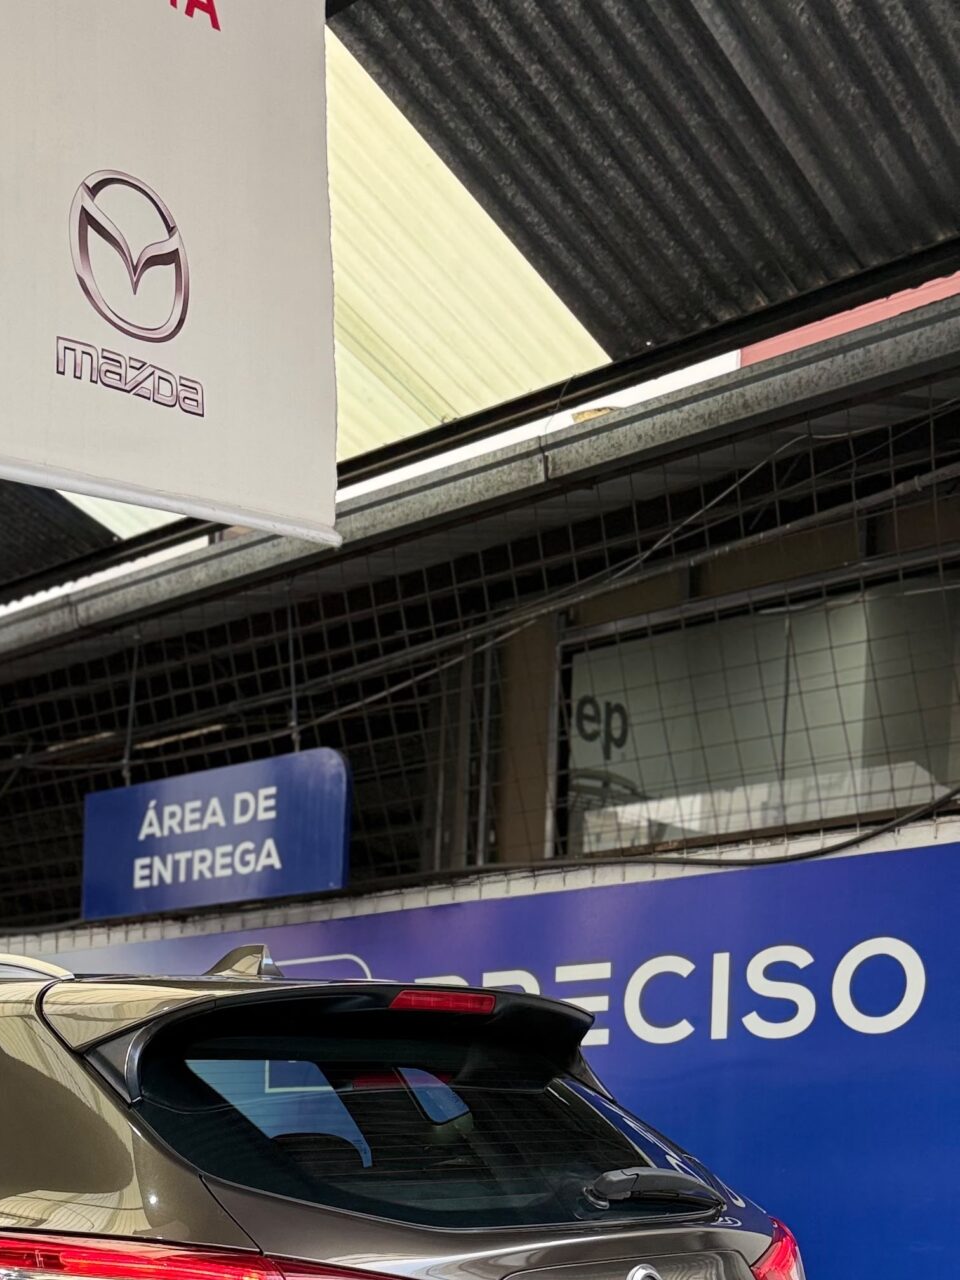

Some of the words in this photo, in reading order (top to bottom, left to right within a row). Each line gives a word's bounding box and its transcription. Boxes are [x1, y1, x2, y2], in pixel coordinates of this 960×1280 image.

[55, 335, 205, 418] mazda
[576, 694, 629, 761] ep
[138, 799, 226, 841] ÁREA
[233, 786, 278, 825] DE
[133, 838, 282, 889] ENTREGA
[415, 936, 925, 1046] ECISO
